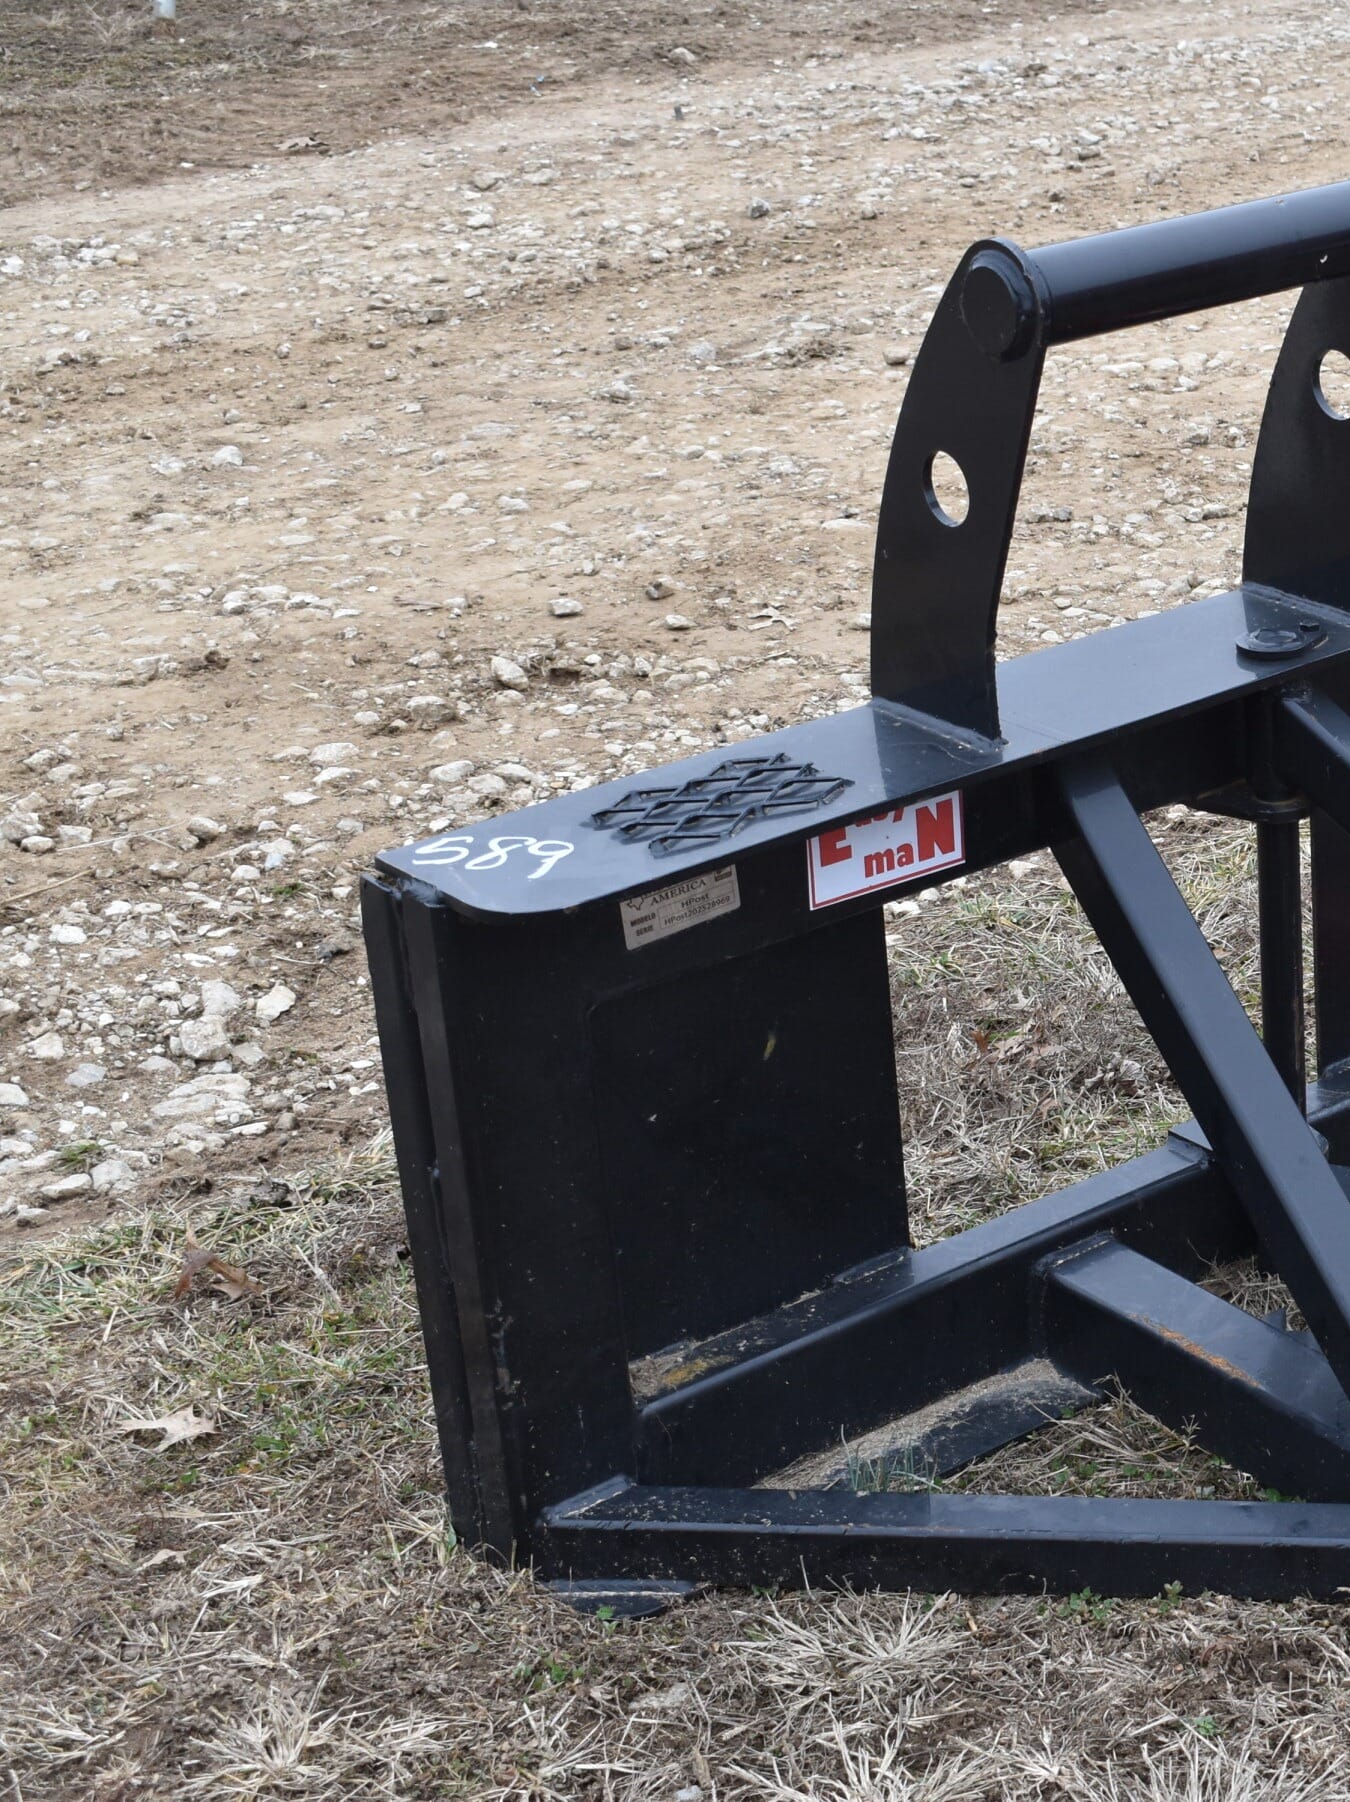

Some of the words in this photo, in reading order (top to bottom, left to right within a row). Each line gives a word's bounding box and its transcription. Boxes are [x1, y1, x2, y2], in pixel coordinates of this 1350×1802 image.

[412, 836, 574, 879] 589
[650, 879, 707, 906] AMERICA
[681, 893, 709, 909] HPost
